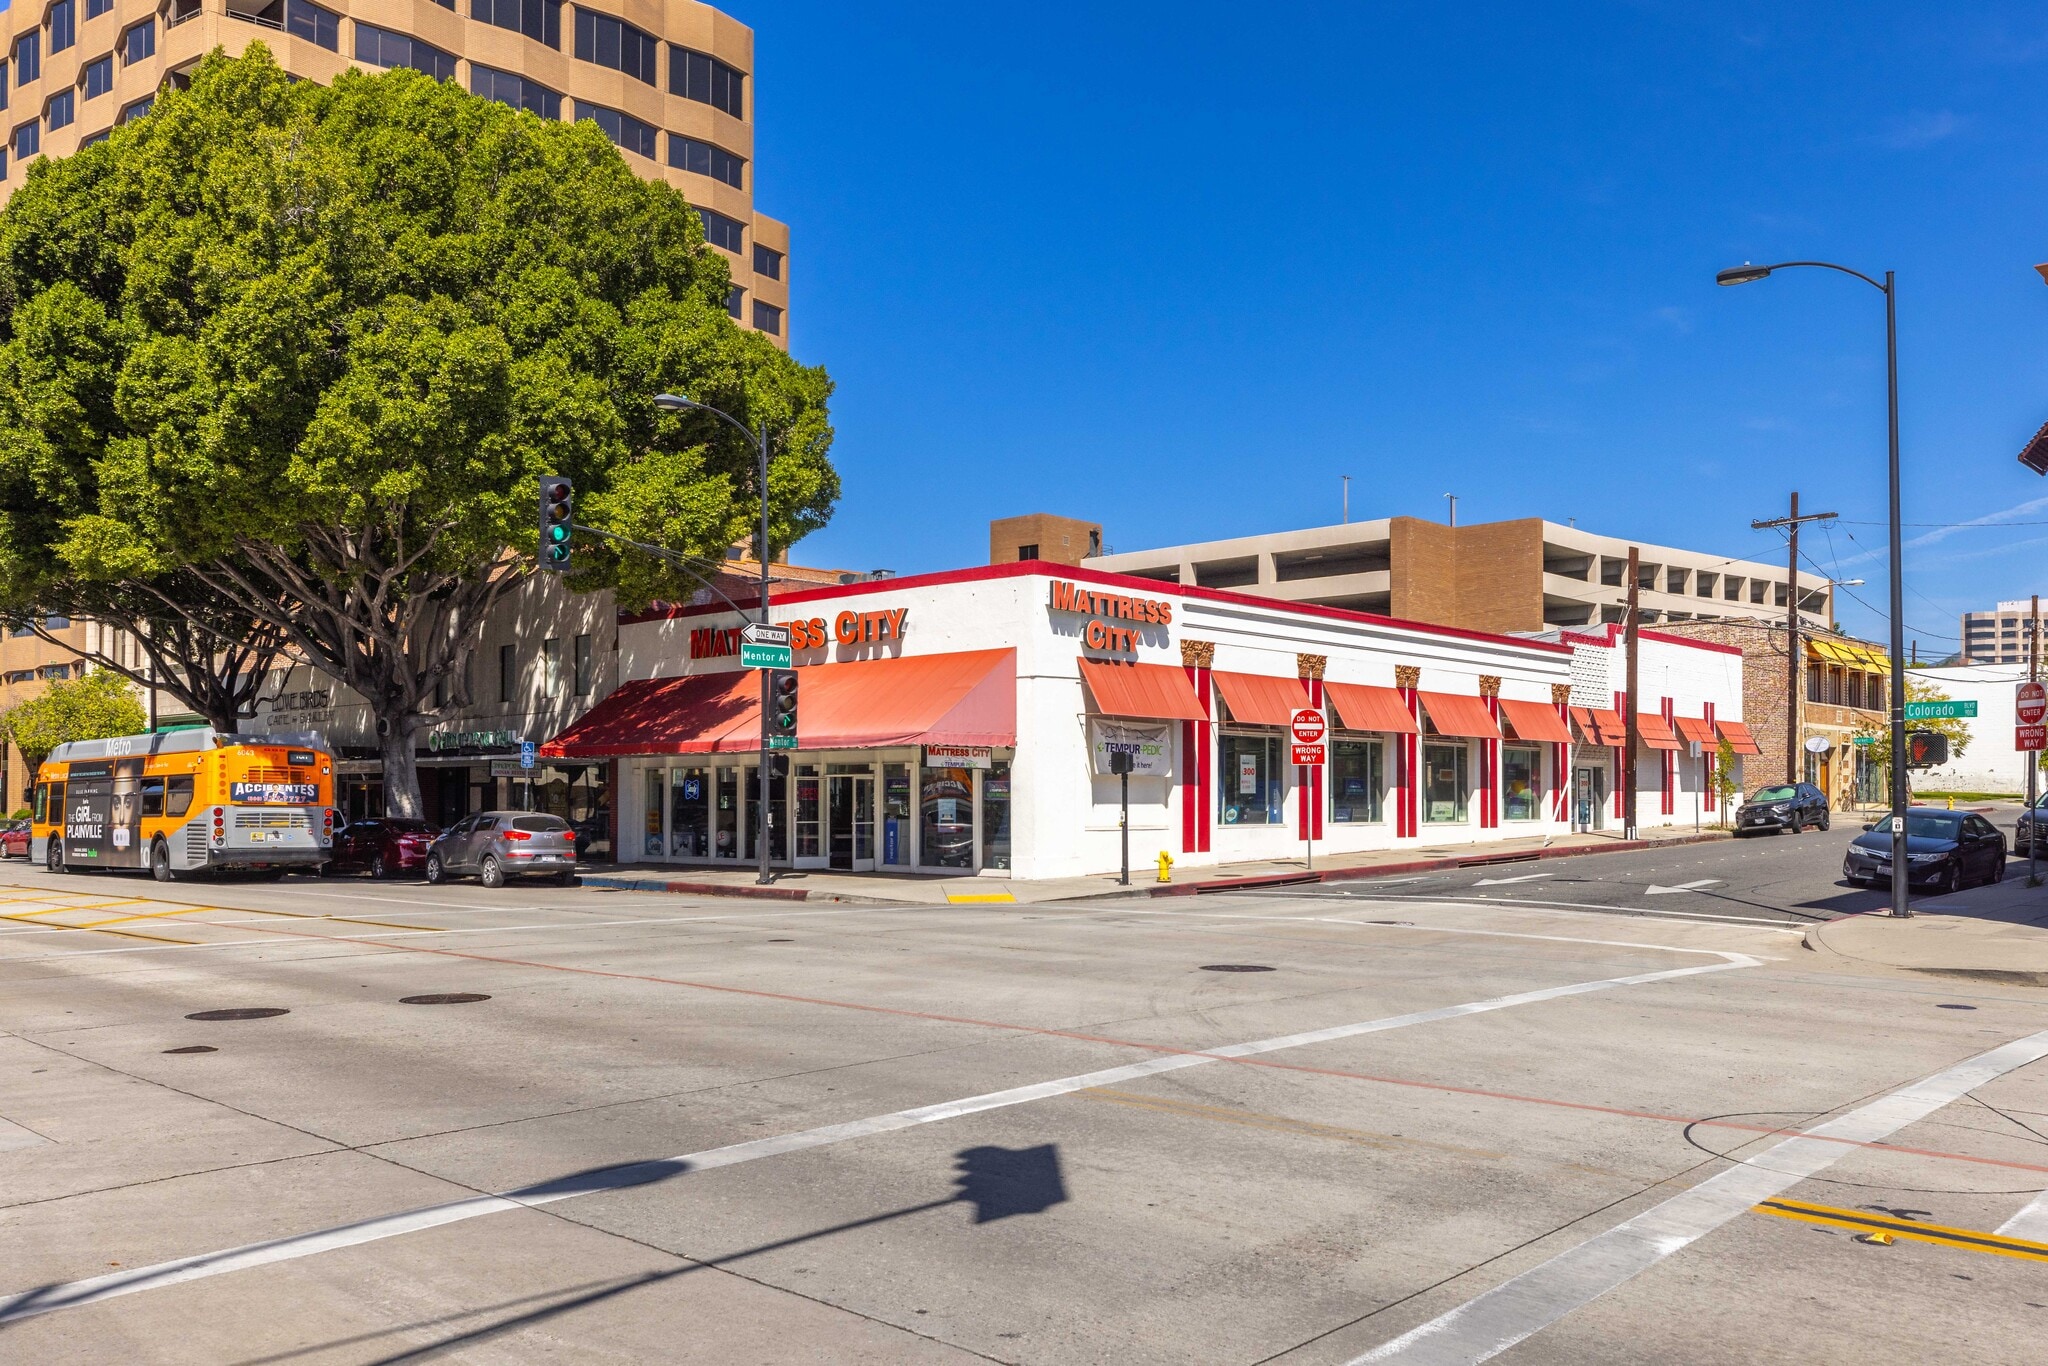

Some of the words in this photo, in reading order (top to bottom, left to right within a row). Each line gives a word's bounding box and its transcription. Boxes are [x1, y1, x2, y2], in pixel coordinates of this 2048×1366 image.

[1050, 580, 1172, 624] MATTRESS
[690, 617, 827, 659] MATSS
[835, 608, 910, 645] CITY
[756, 629, 770, 639] ONE
[771, 631, 785, 640] WAY
[1084, 620, 1141, 652] CITY
[743, 651, 776, 662] Mentor
[778, 655, 790, 663] Av
[2020, 691, 2029, 699] DO
[2031, 689, 2043, 698] NOT
[1908, 704, 1955, 717] Colorado
[2022, 708, 2041, 717] ENTER
[2019, 728, 2044, 738] WRONG
[105, 739, 132, 757] Metro
[2023, 738, 2040, 748] WAY
[928, 746, 970, 757] MATTRESS
[971, 747, 990, 758] CITY
[1295, 746, 1322, 754] WRONG
[234, 782, 315, 797] ACCIDENTES
[68, 813, 76, 823] THE
[75, 806, 92, 823] GIRL
[92, 813, 104, 823] FROM
[67, 824, 103, 839] PLAINVILLE
